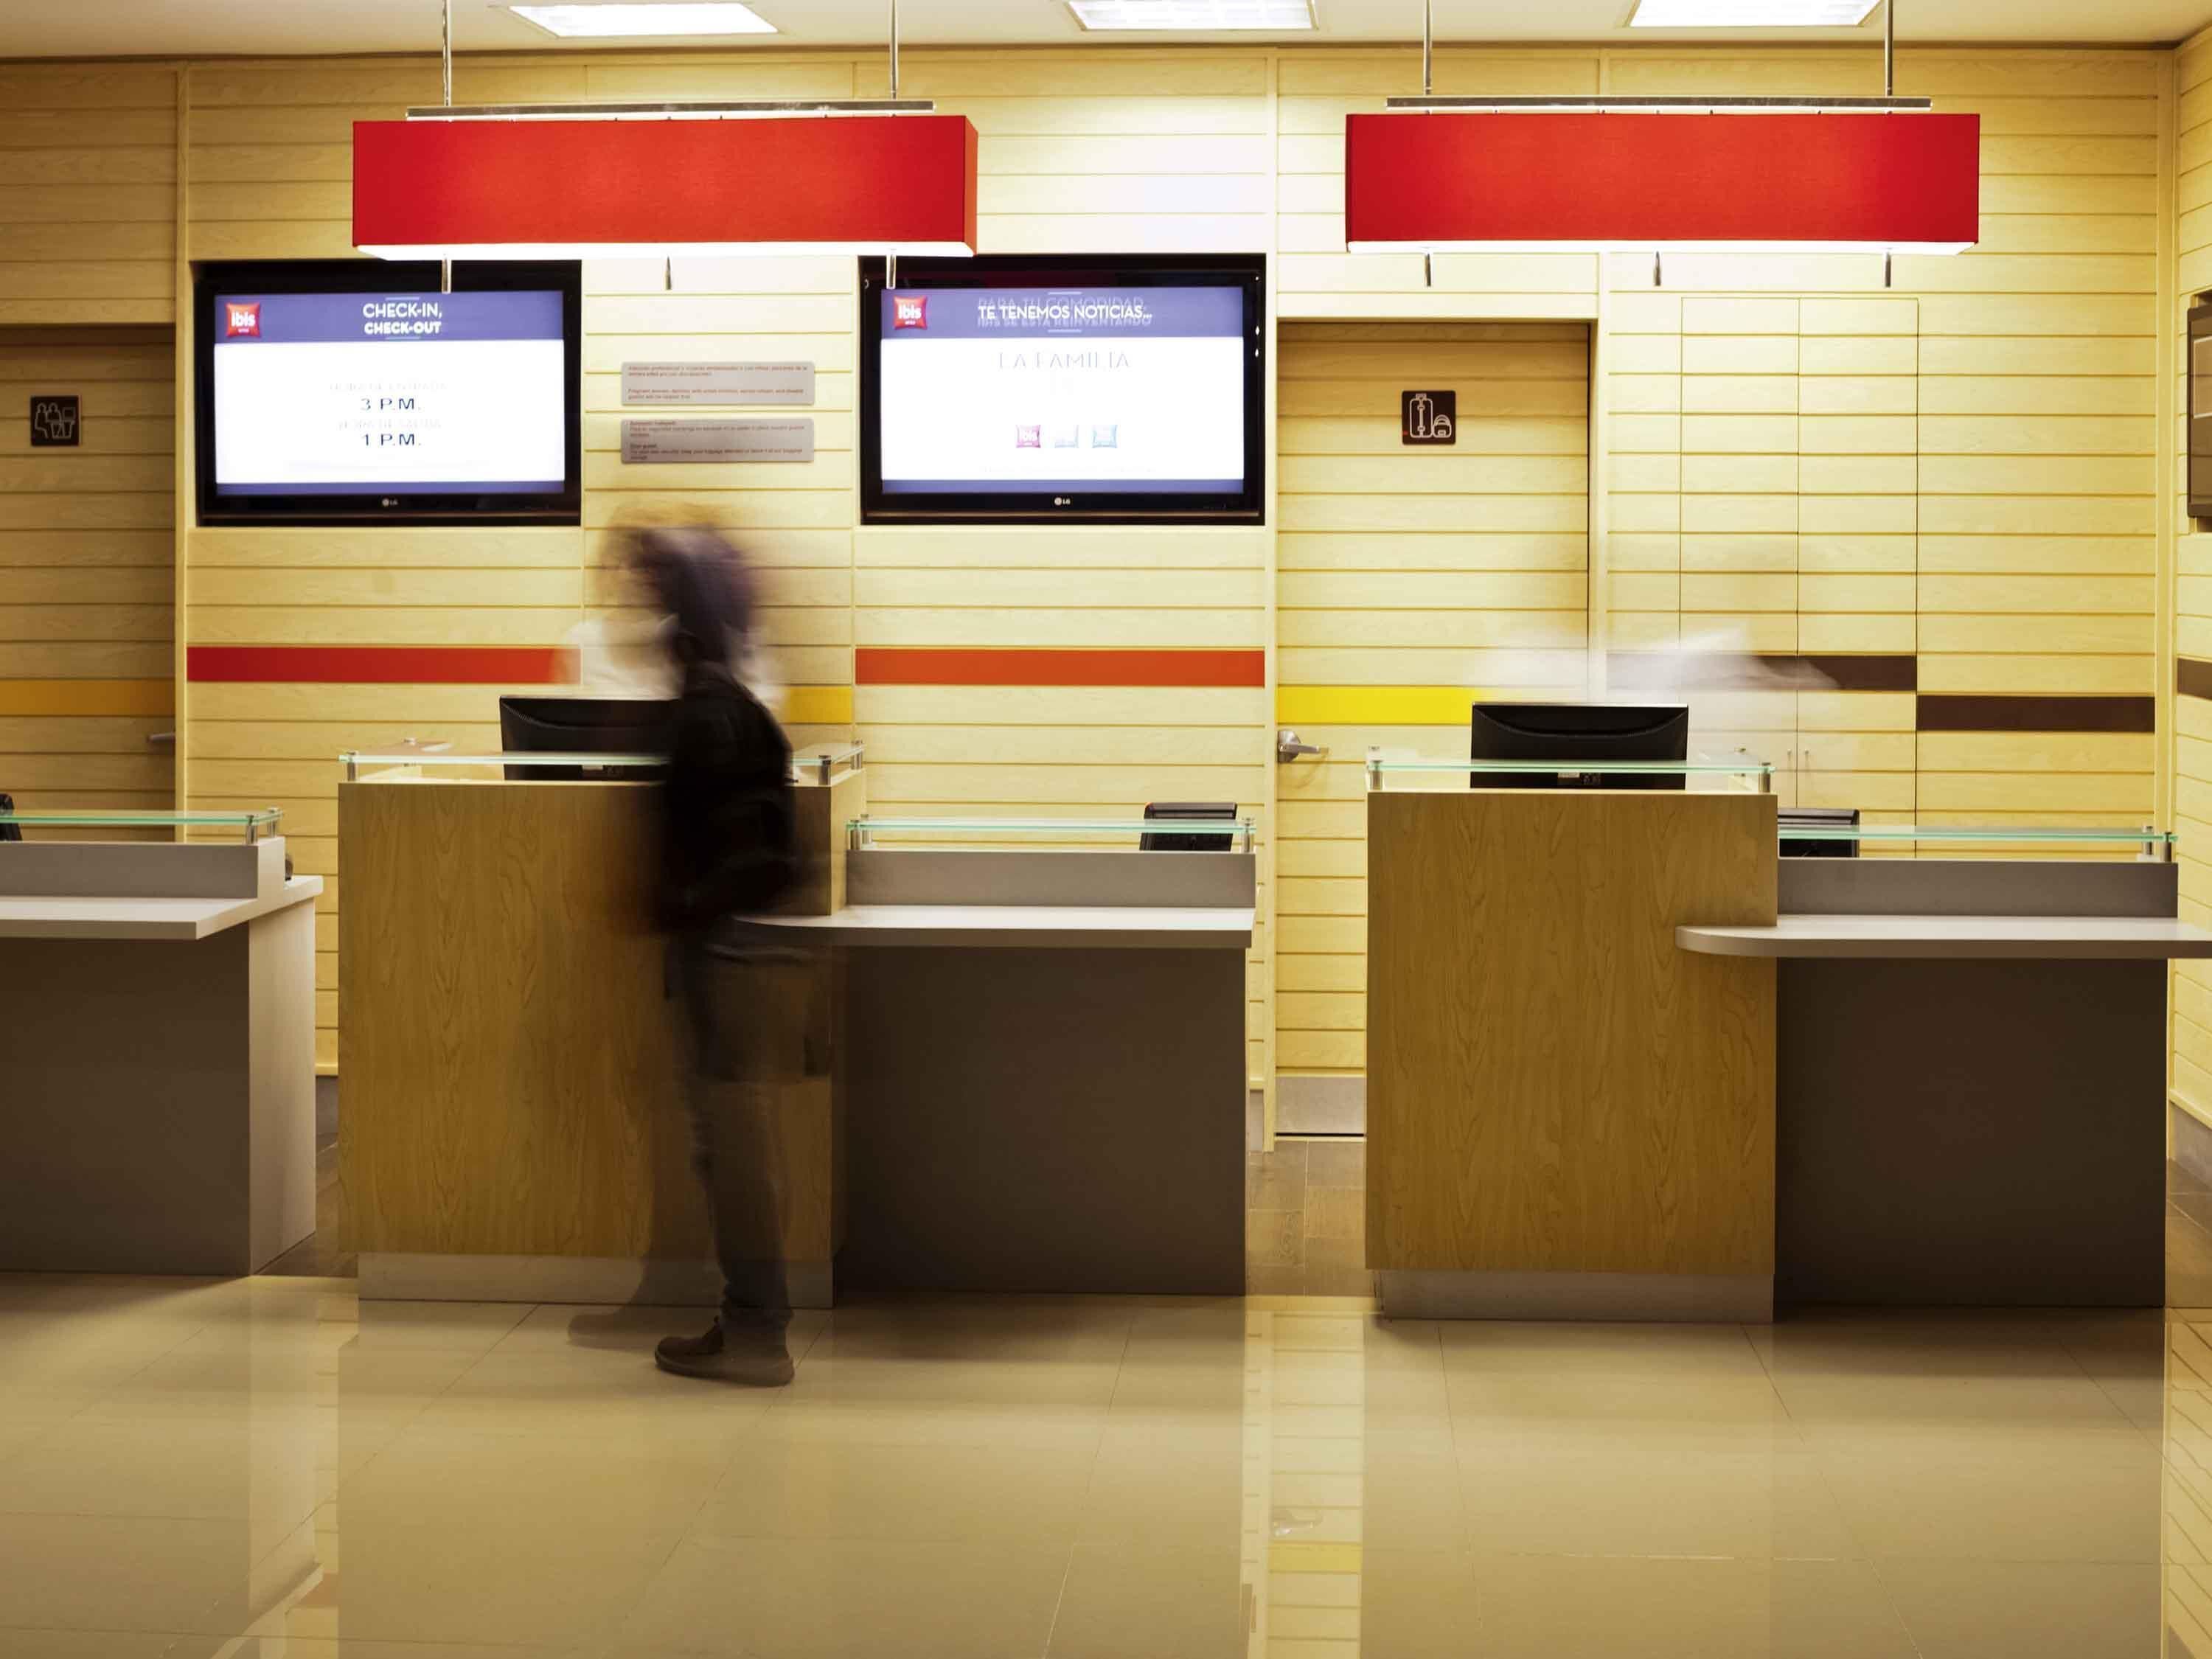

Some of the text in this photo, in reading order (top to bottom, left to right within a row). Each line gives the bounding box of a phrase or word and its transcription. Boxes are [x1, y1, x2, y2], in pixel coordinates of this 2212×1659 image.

[362, 302, 442, 319] CHECK-IN,
[898, 305, 922, 319] ibis
[978, 305, 1152, 319] TE TENEMOS NOTICIAS...
[231, 311, 256, 327] ibis
[364, 321, 442, 335] CHECK-OUT
[360, 397, 421, 410] 3 P.M.
[361, 433, 421, 446] 1 P.M.
